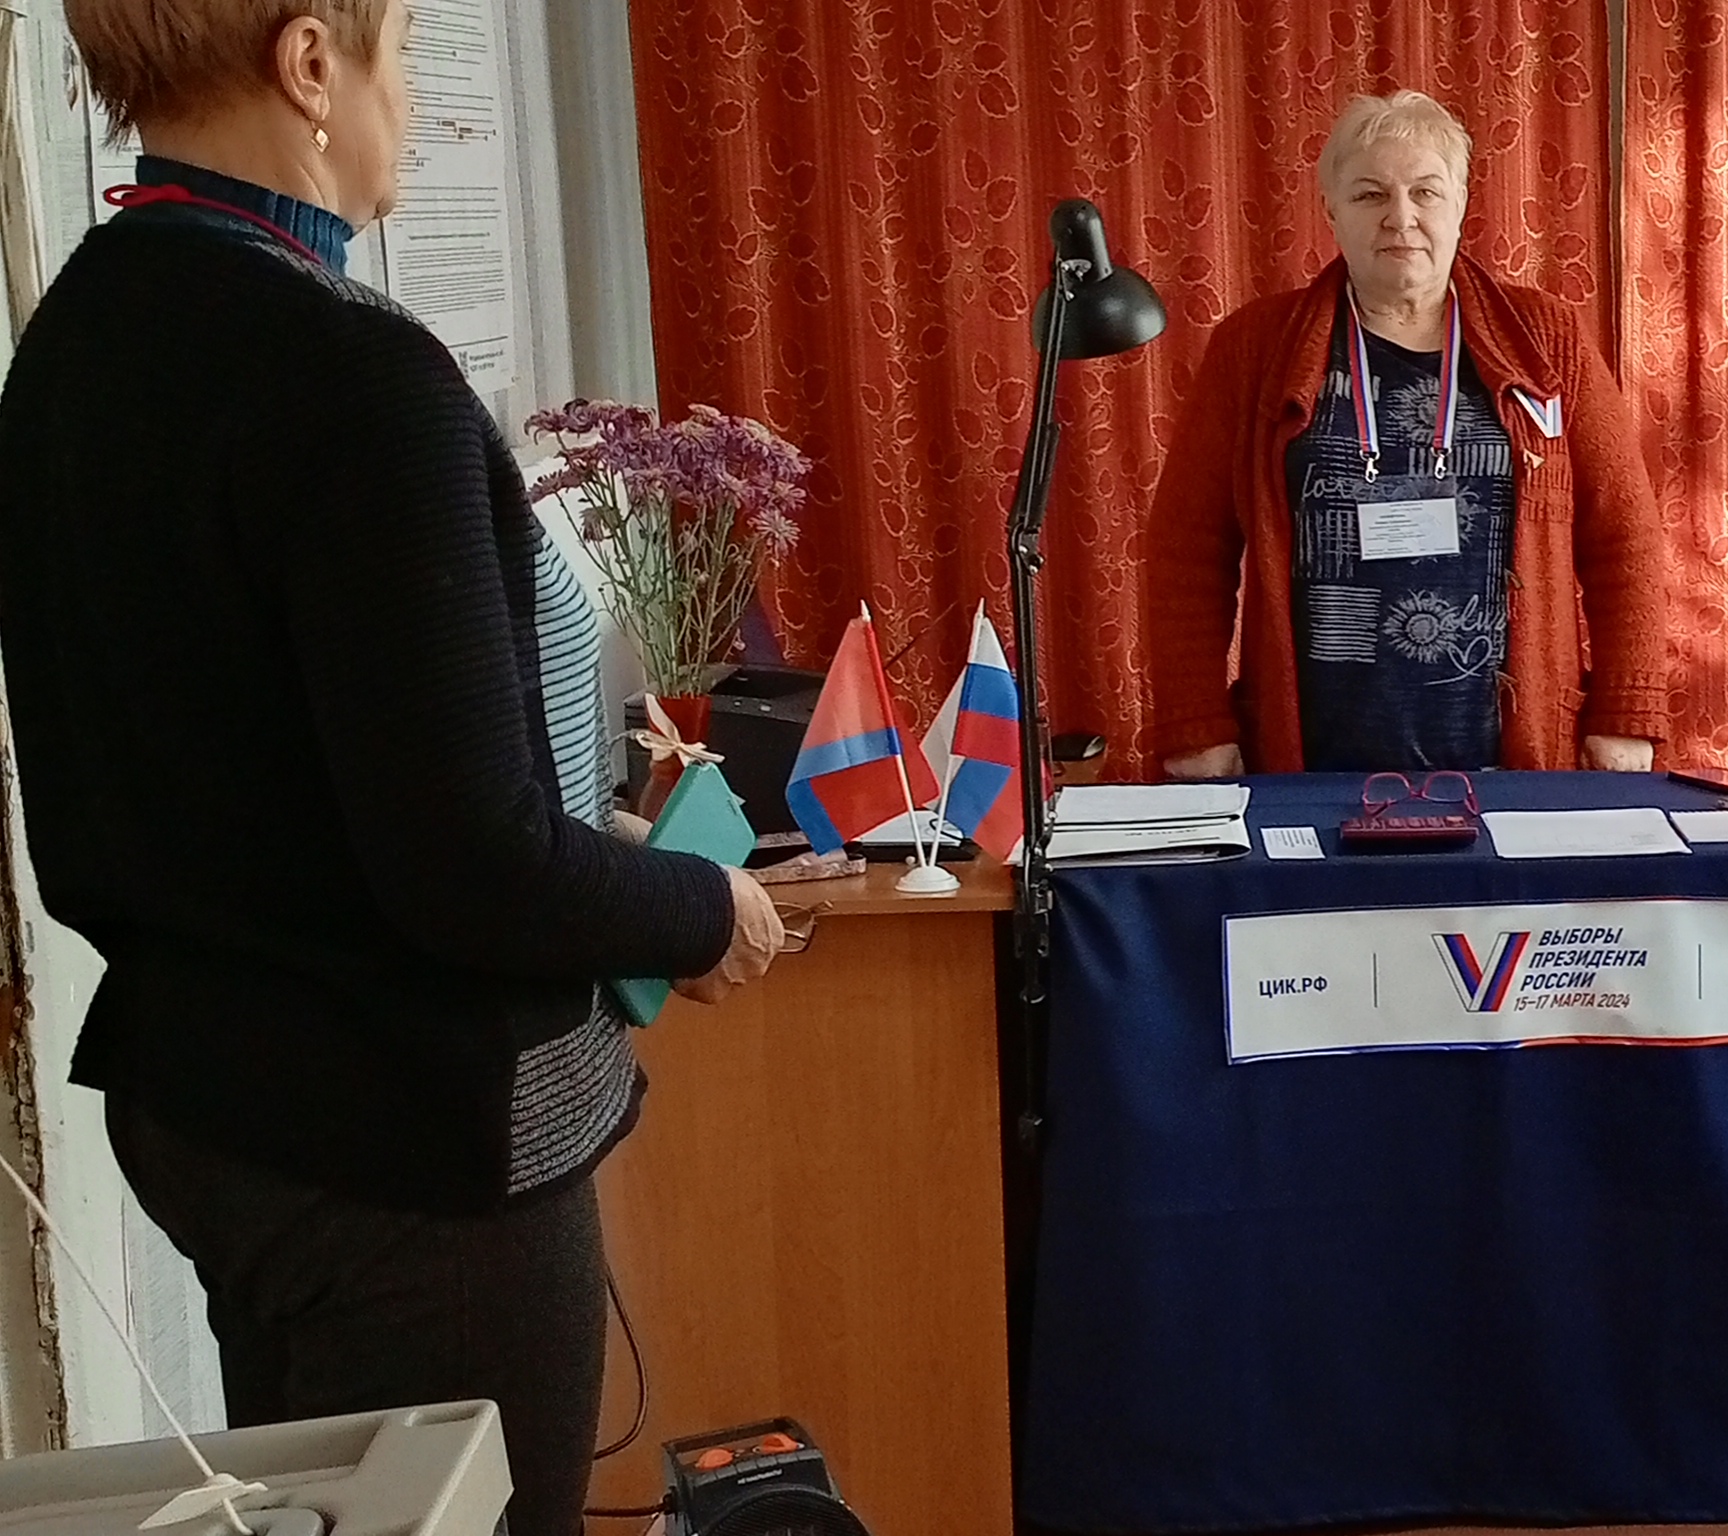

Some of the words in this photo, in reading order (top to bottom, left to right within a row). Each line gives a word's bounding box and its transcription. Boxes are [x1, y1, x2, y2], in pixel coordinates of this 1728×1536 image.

[1538, 927, 1624, 946] ВЫБОРЫ
[1528, 950, 1648, 969] ПРЕЗИДЕНТА
[1259, 976, 1328, 998] ЦИК.РФ
[1520, 972, 1596, 991] РОССИИ
[1551, 994, 1596, 1009] МАРТА
[1597, 993, 1631, 1009] 2024
